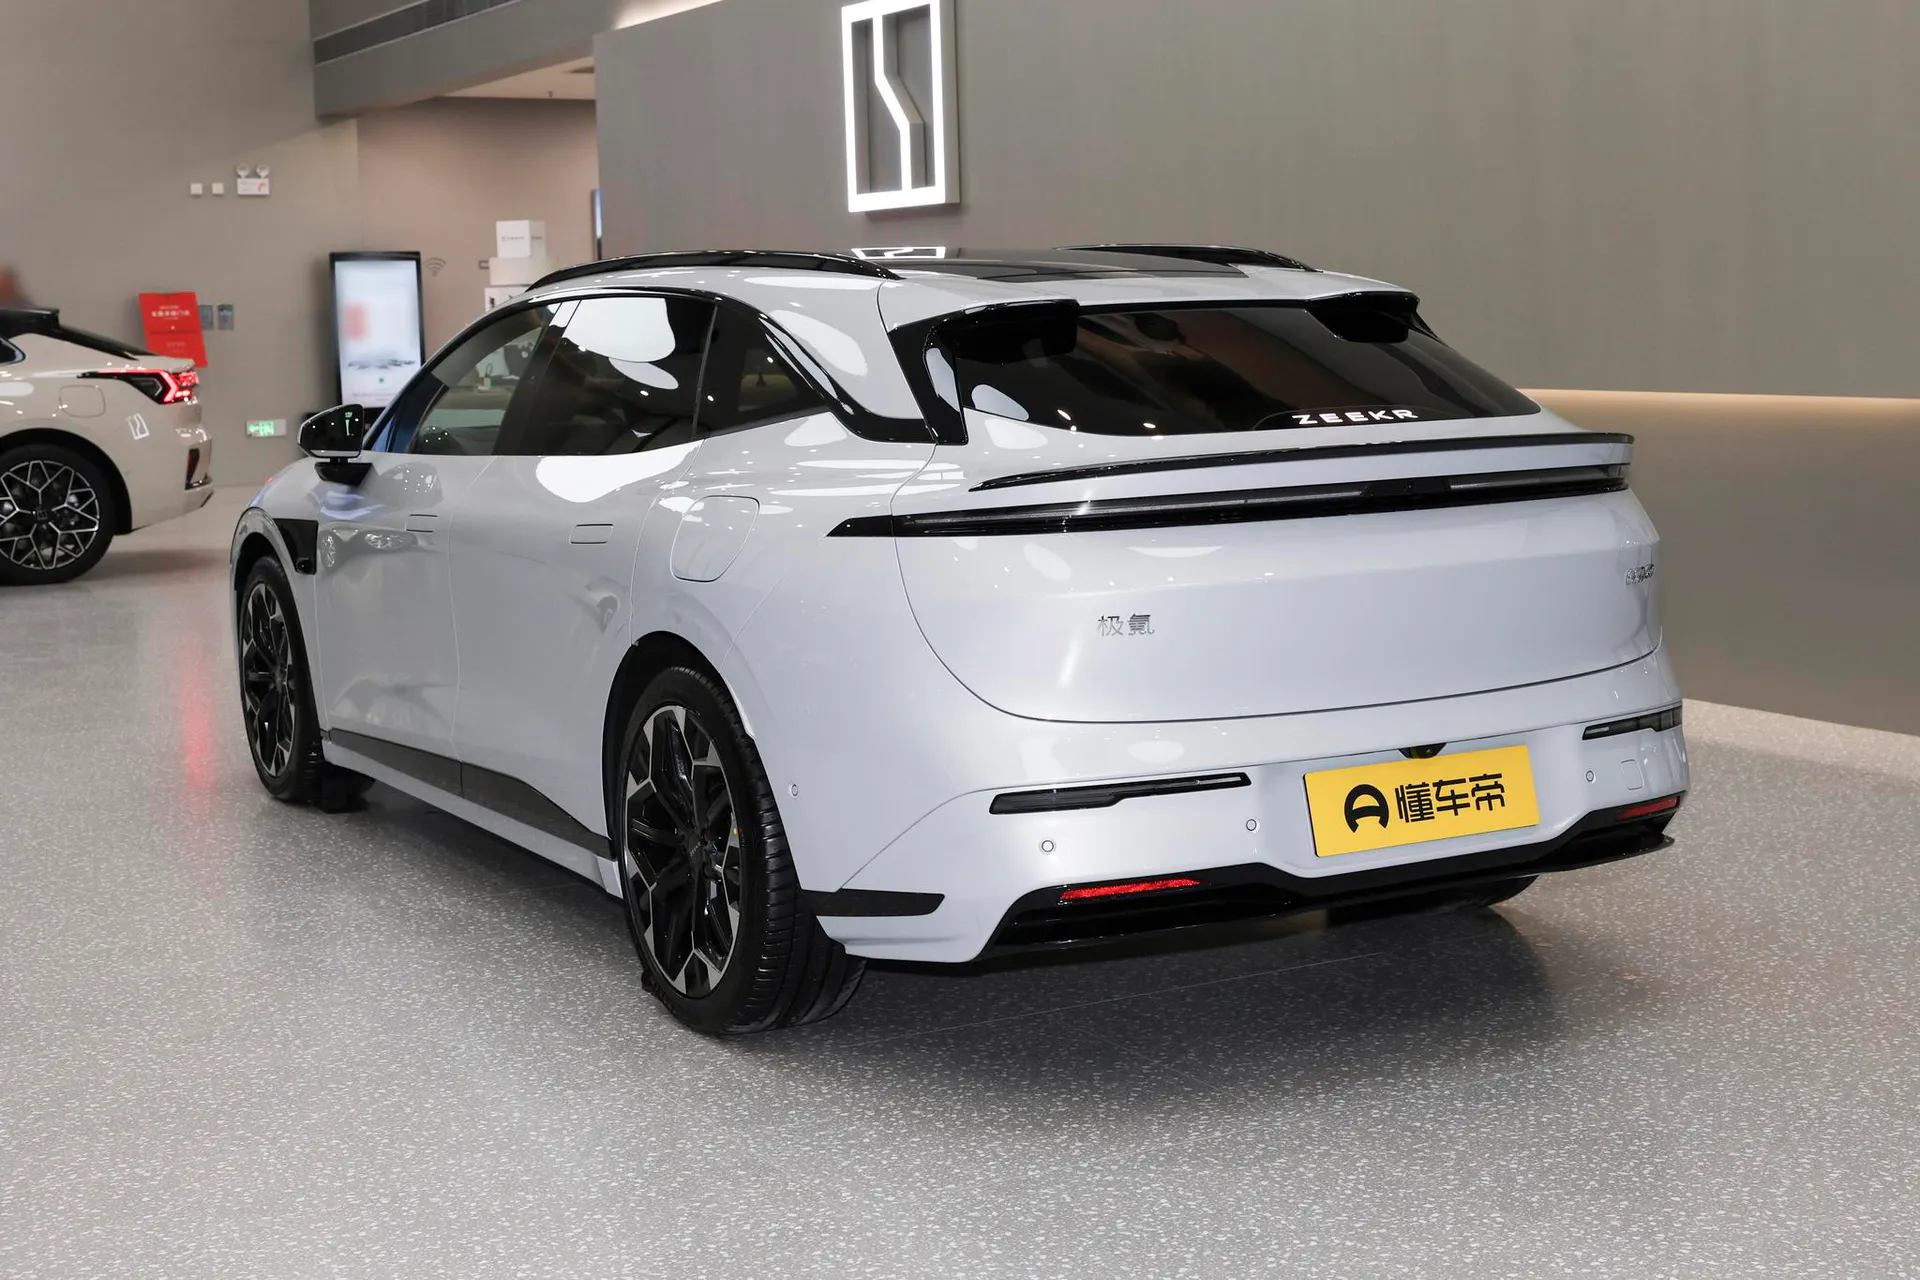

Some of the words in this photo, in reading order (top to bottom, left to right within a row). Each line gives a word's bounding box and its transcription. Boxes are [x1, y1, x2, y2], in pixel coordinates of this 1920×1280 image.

[1291, 408, 1419, 425] ZEEKR
[1097, 612, 1155, 637] 极氪
[1394, 772, 1506, 824] 懂车帝
